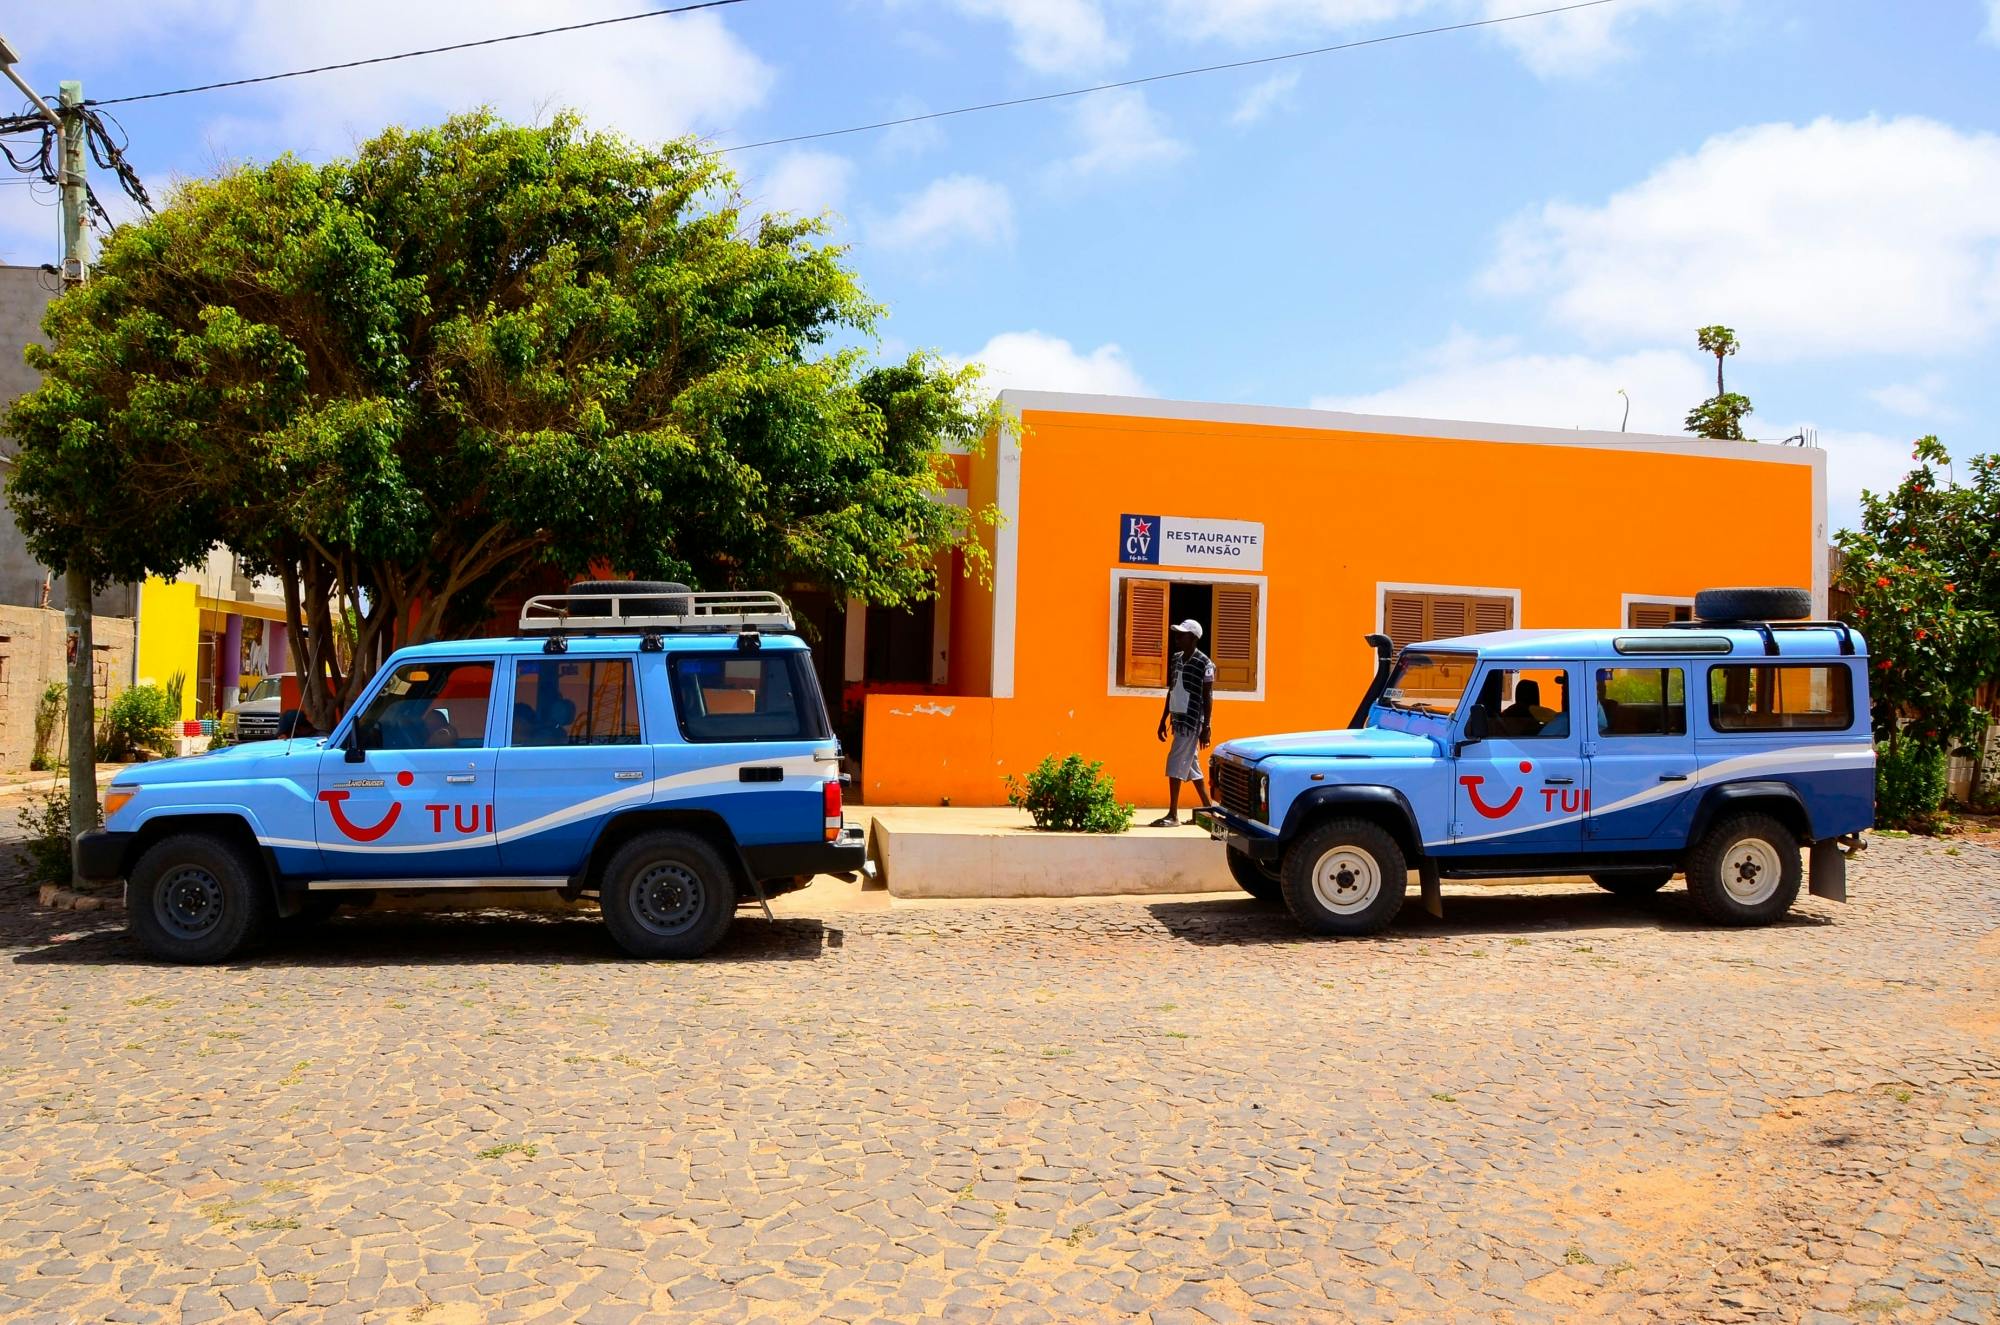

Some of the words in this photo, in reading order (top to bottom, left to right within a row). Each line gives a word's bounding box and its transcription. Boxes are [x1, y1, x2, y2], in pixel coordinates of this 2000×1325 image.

[1126, 536, 1151, 555] CV
[1166, 530, 1258, 545] RESTAURANTE
[1186, 544, 1241, 556] MANSÃO
[1539, 788, 1590, 813] TUI
[425, 804, 493, 833] TUI
